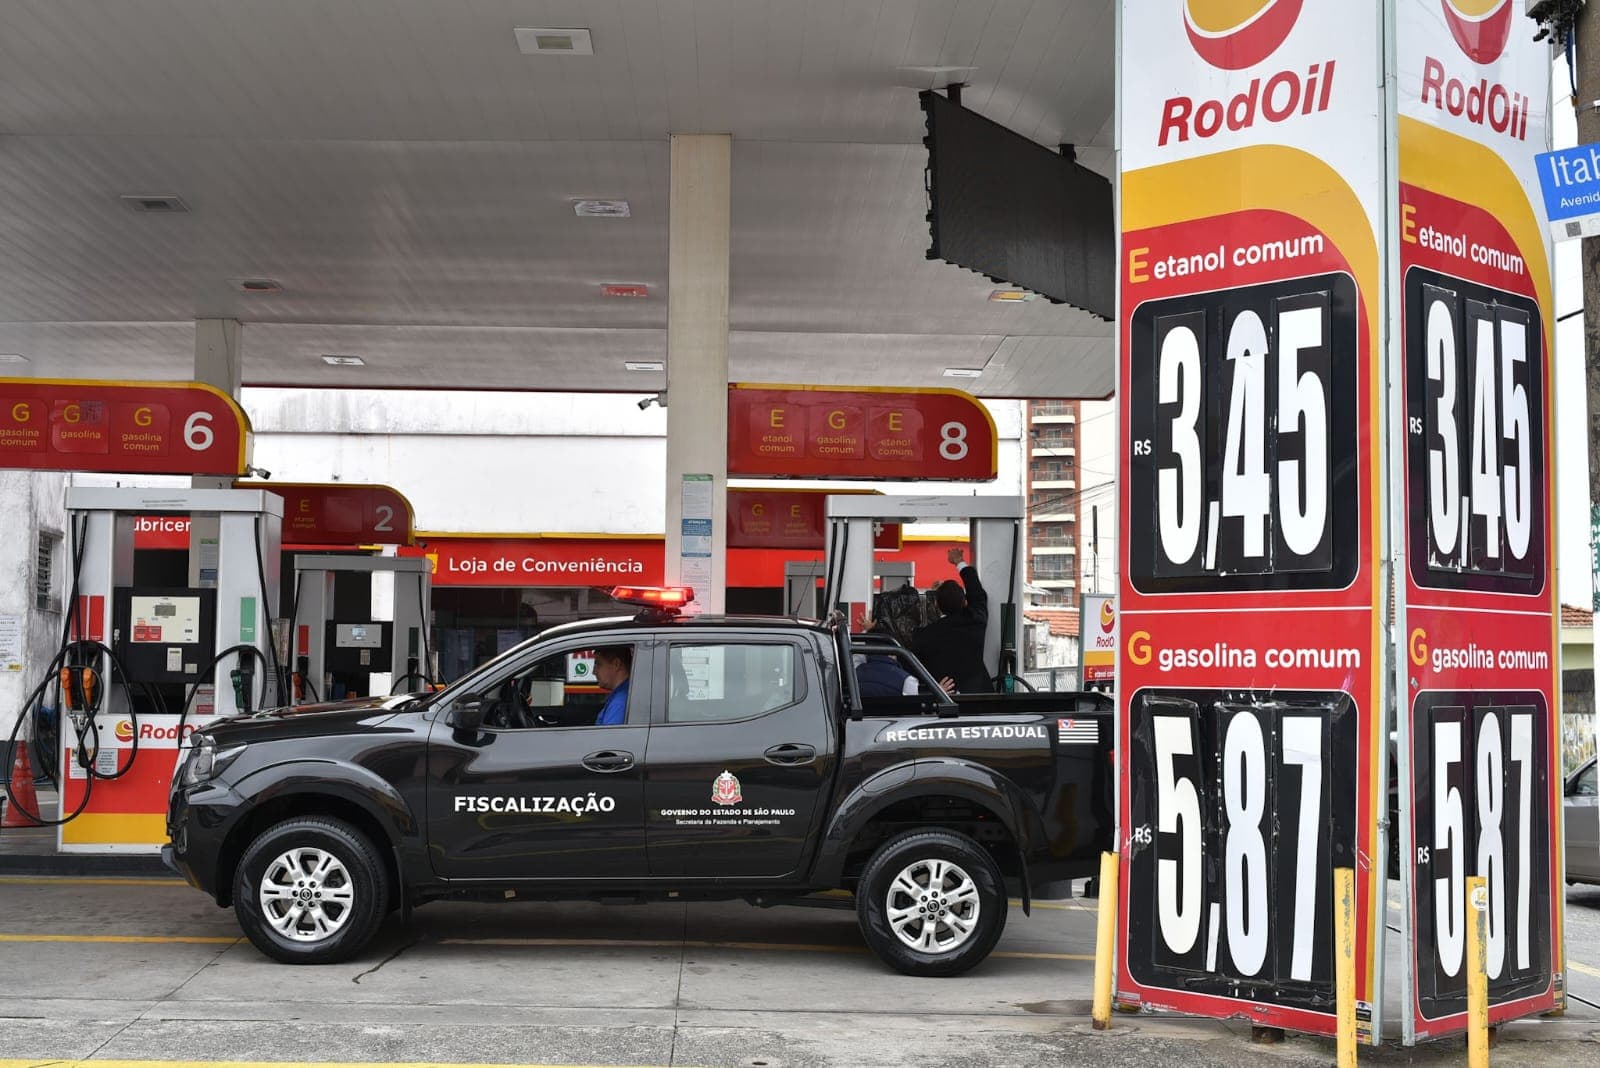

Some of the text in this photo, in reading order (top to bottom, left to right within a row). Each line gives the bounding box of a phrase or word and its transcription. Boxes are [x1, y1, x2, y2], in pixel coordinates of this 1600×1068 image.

[1158, 60, 1336, 147] RodOil
[1421, 56, 1528, 141] RodOil
[1402, 204, 1524, 274] E etanol comum
[1129, 233, 1324, 284] E etanol comum
[12, 403, 31, 422] G
[63, 404, 81, 423] G
[134, 407, 152, 426] G
[770, 409, 785, 428] E
[828, 411, 846, 430] G
[888, 413, 903, 431] E
[0, 428, 40, 437] gasolina
[60, 430, 101, 440] gasolina
[122, 432, 162, 442] gasolina
[183, 411, 214, 450] 6
[762, 434, 793, 444] etanol
[1134, 307, 1327, 570] R$ 3,45
[1409, 417, 1423, 435] R$
[1427, 300, 1531, 567] 3,45
[123, 443, 159, 451] comum
[759, 444, 795, 453] comum
[817, 436, 857, 446] gasolina
[880, 438, 912, 447] etanol
[939, 421, 969, 461] 8
[878, 448, 913, 456] comum
[374, 505, 394, 531] 2
[449, 557, 643, 574] Loja de Conveniência
[1128, 630, 1360, 671] G gasolina comum
[1410, 628, 1548, 673] G gasolina comum
[886, 726, 1046, 742] RECEITA ESTADUAL
[454, 793, 616, 816] FISCALIZAÇÃO
[753, 807, 770, 816] SÃO
[1135, 711, 1323, 981] R$ 5,87
[1417, 711, 1533, 980] R$ 587
